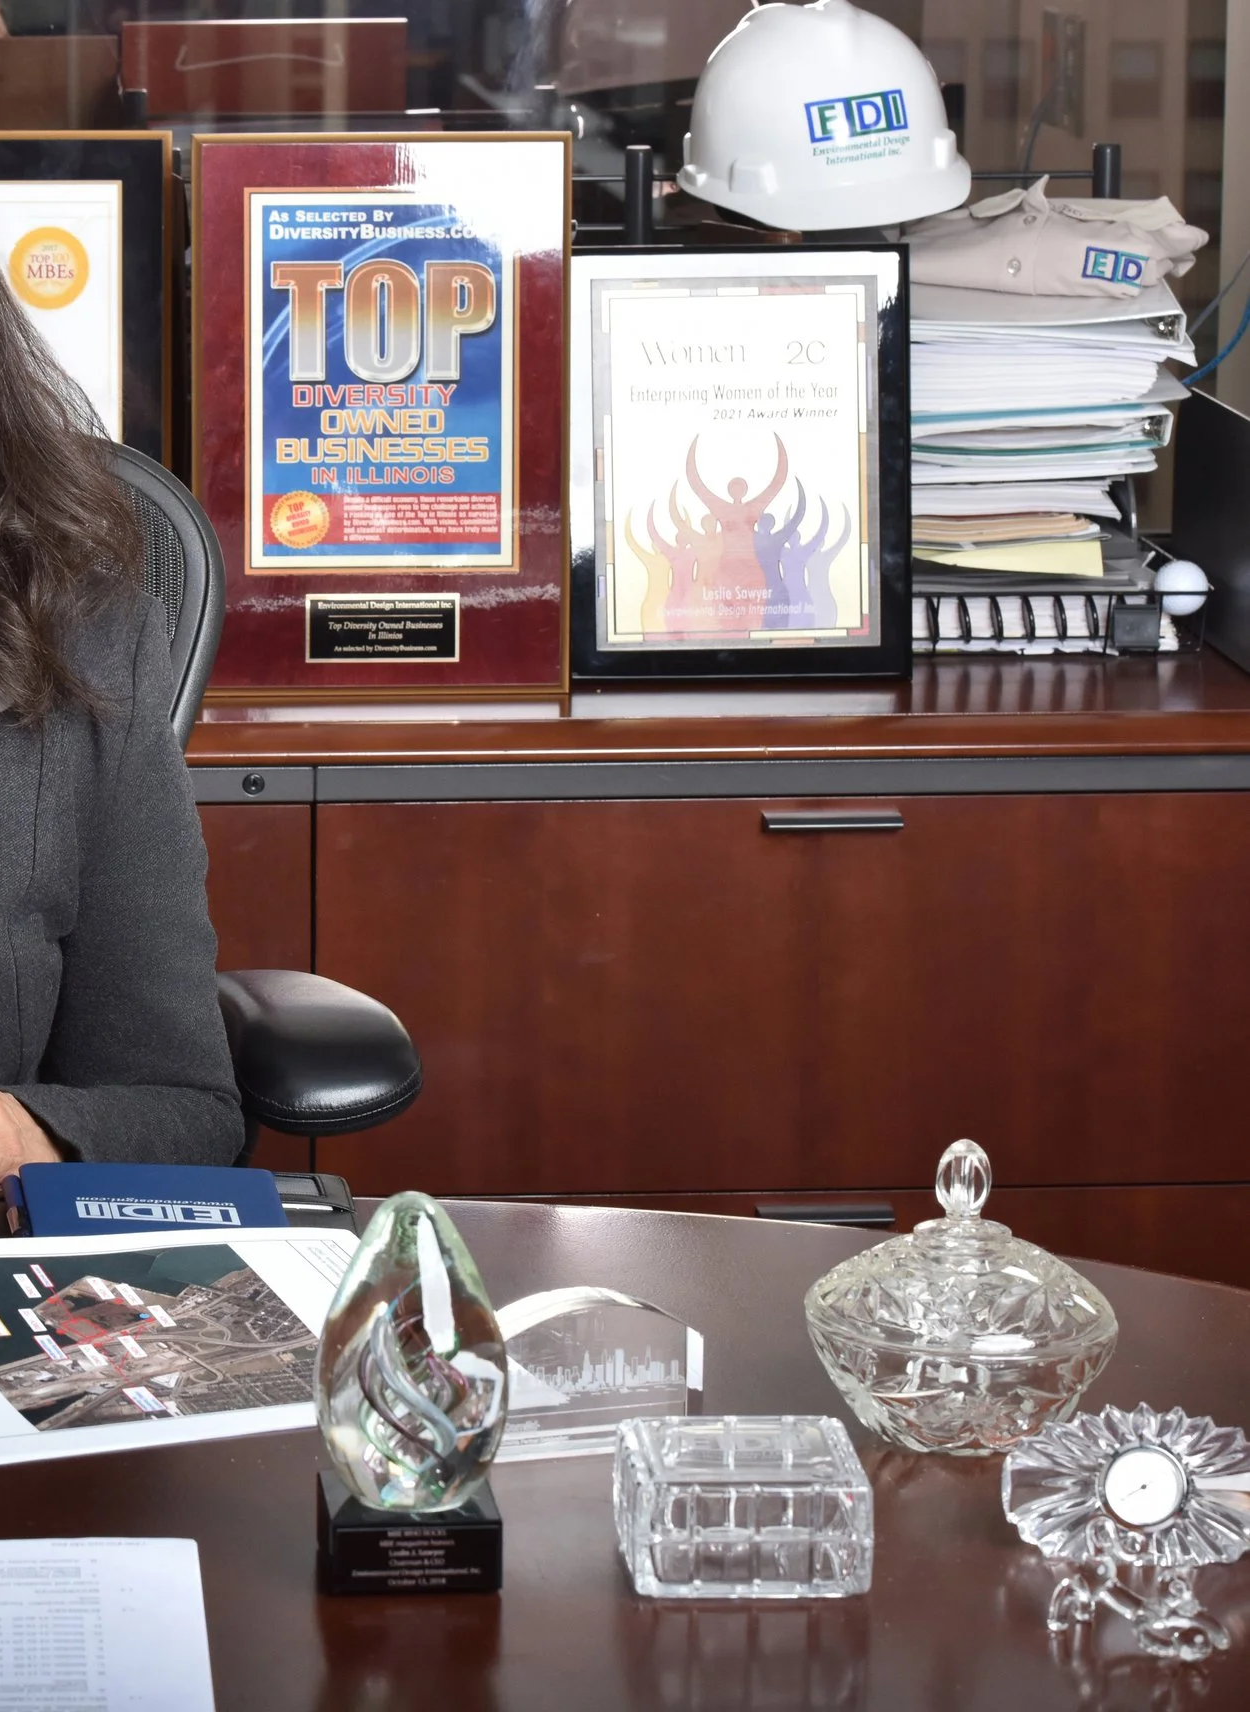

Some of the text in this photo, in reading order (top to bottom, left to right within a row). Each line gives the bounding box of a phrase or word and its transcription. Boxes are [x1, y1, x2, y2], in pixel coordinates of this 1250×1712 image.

[884, 135, 910, 147] Design
[826, 148, 886, 165] International
[30, 254, 50, 263] TOP
[27, 264, 74, 279] MBEs
[271, 258, 496, 383] TOP
[292, 384, 457, 408] DIVERSITY
[630, 381, 838, 405] Enterprising Women of the Year
[321, 408, 445, 434] OWNED
[713, 407, 838, 420] 2021 Award Winner
[276, 437, 489, 464] BUSINESSES
[311, 466, 455, 485] IN ILLINOIS
[287, 501, 304, 513] TOP
[702, 586, 773, 602] Leslie Sawyer
[317, 602, 369, 610] Environmental
[370, 601, 394, 611] Design
[395, 601, 440, 609] International
[748, 602, 801, 616] International
[328, 620, 443, 631] Top Diversity Owned Businesses
[368, 632, 376, 640] In
[366, 645, 373, 653] by
[80, 1202, 236, 1224] EDI
